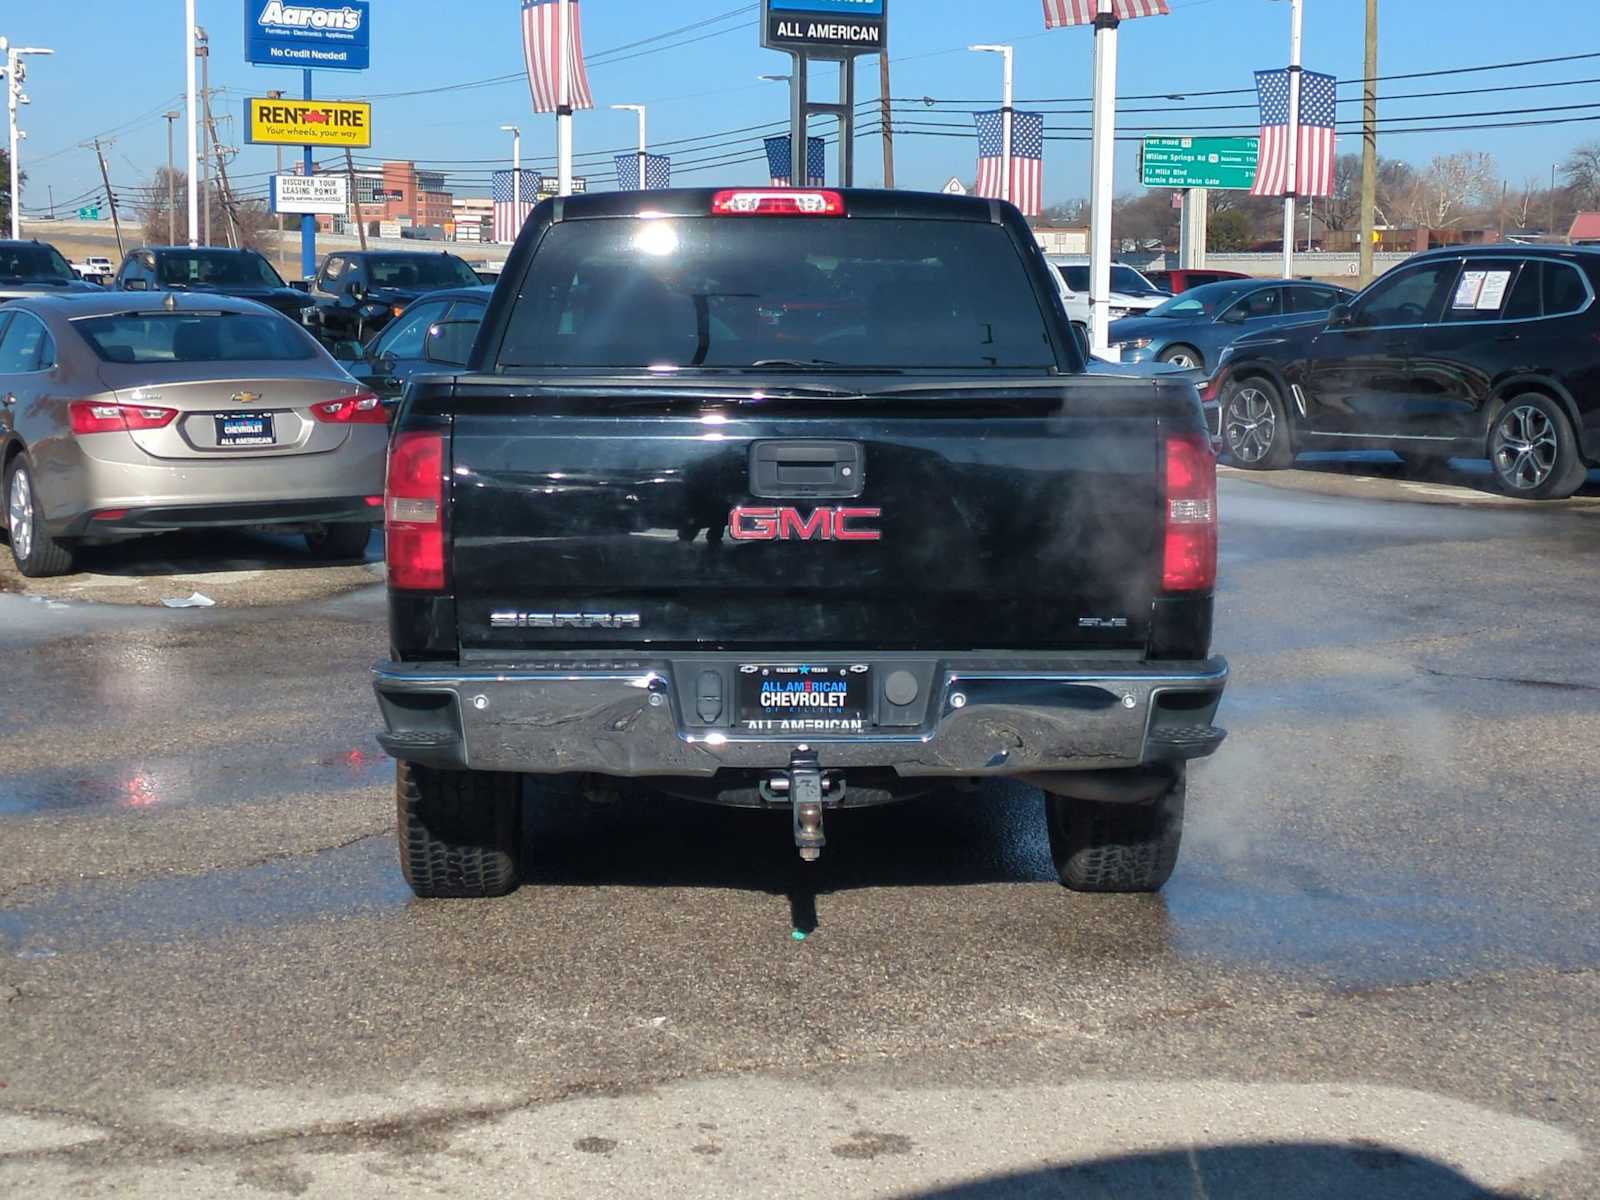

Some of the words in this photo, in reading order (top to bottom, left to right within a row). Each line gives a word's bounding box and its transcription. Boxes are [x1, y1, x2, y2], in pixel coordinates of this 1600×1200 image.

[260, 0, 359, 30] Aaron's
[777, 22, 803, 37] ALL
[807, 24, 879, 41] AMERICAN
[270, 48, 283, 56] No
[284, 49, 310, 58] Credit
[311, 50, 347, 60] Needed!
[259, 106, 309, 124] RENT
[321, 109, 363, 127] TIRE
[266, 126, 285, 135] Your
[320, 130, 338, 138] your
[282, 178, 315, 187] DISCOVER
[282, 186, 311, 196] LEASING
[314, 187, 338, 196] POWER
[729, 506, 881, 541] GMC
[490, 612, 641, 628] SIERRA
[762, 682, 784, 692] ALL
[785, 679, 847, 692] AMERICAN
[760, 692, 847, 707] CHEVROLET
